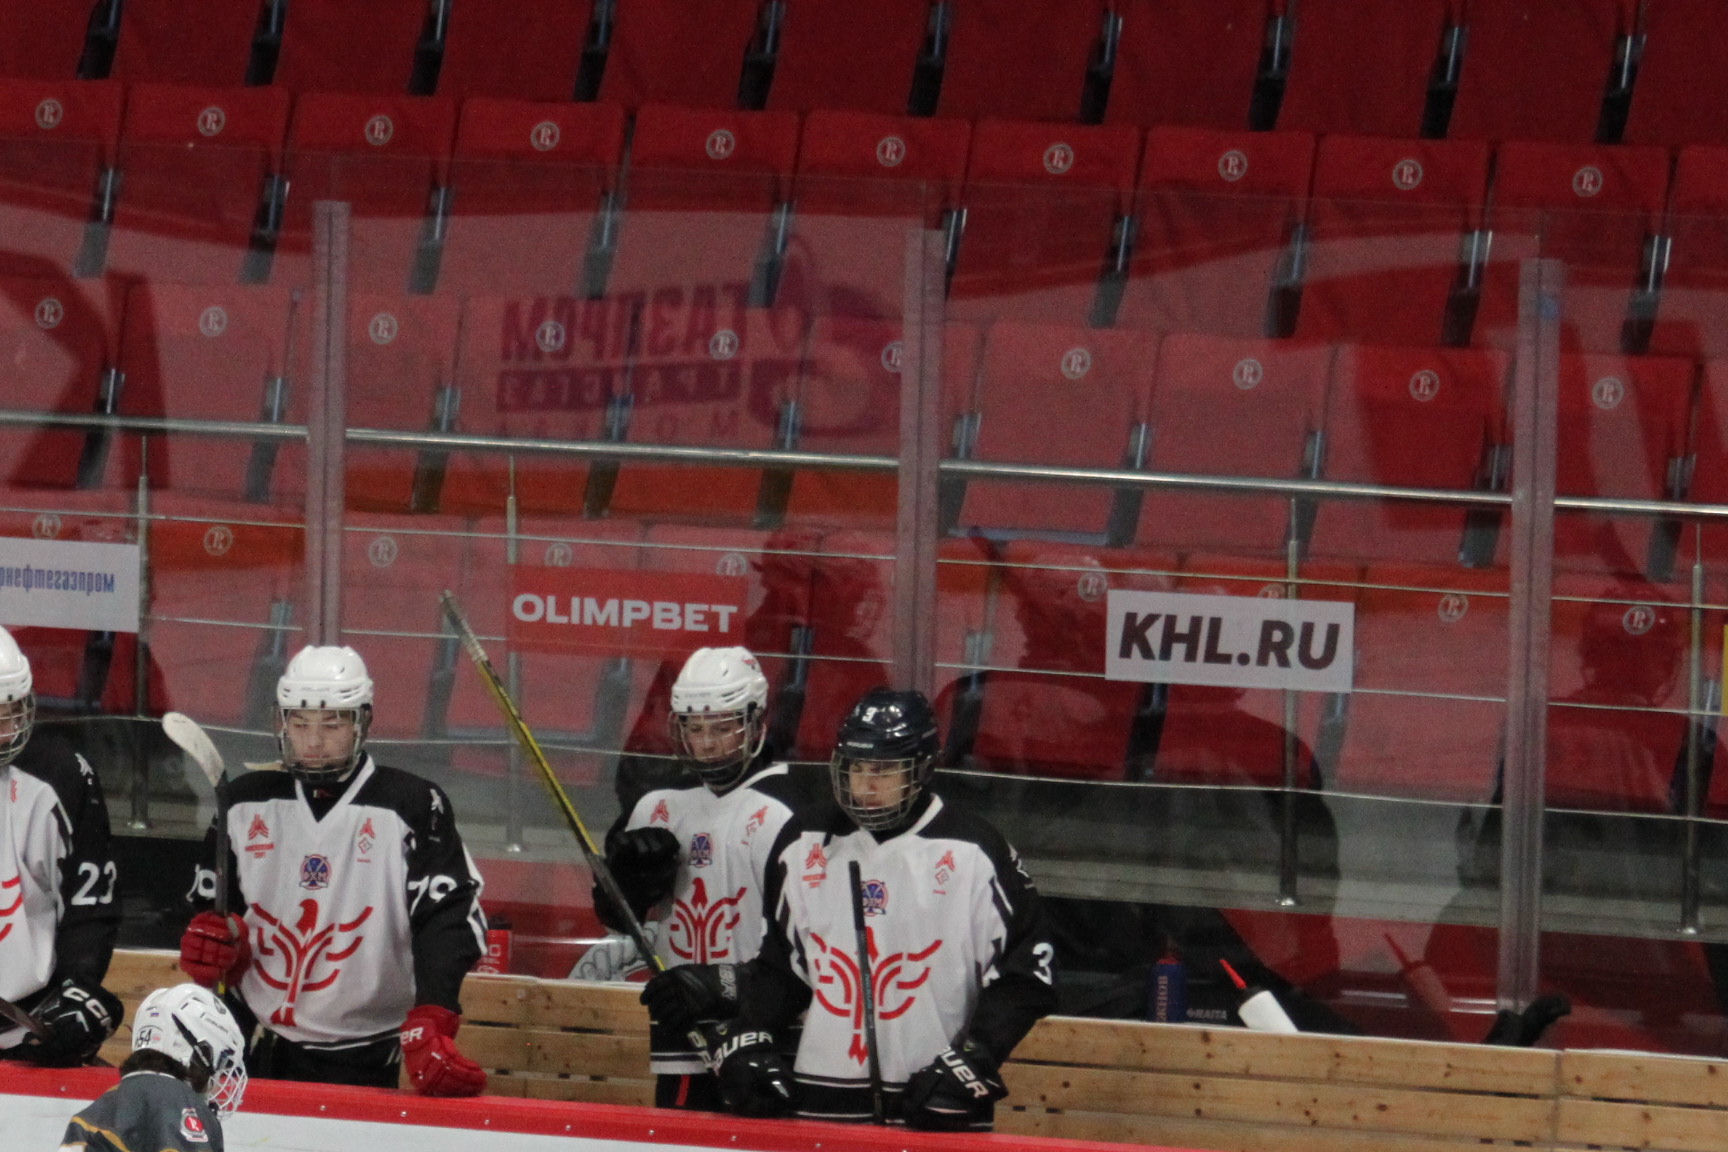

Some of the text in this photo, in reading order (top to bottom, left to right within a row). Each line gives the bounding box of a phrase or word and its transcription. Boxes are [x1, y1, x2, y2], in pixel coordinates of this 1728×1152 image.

[512, 593, 739, 633] OLIMPBET
[1118, 611, 1341, 671] KHL.RU
[71, 860, 118, 906] 23
[1032, 942, 1055, 986] 3
